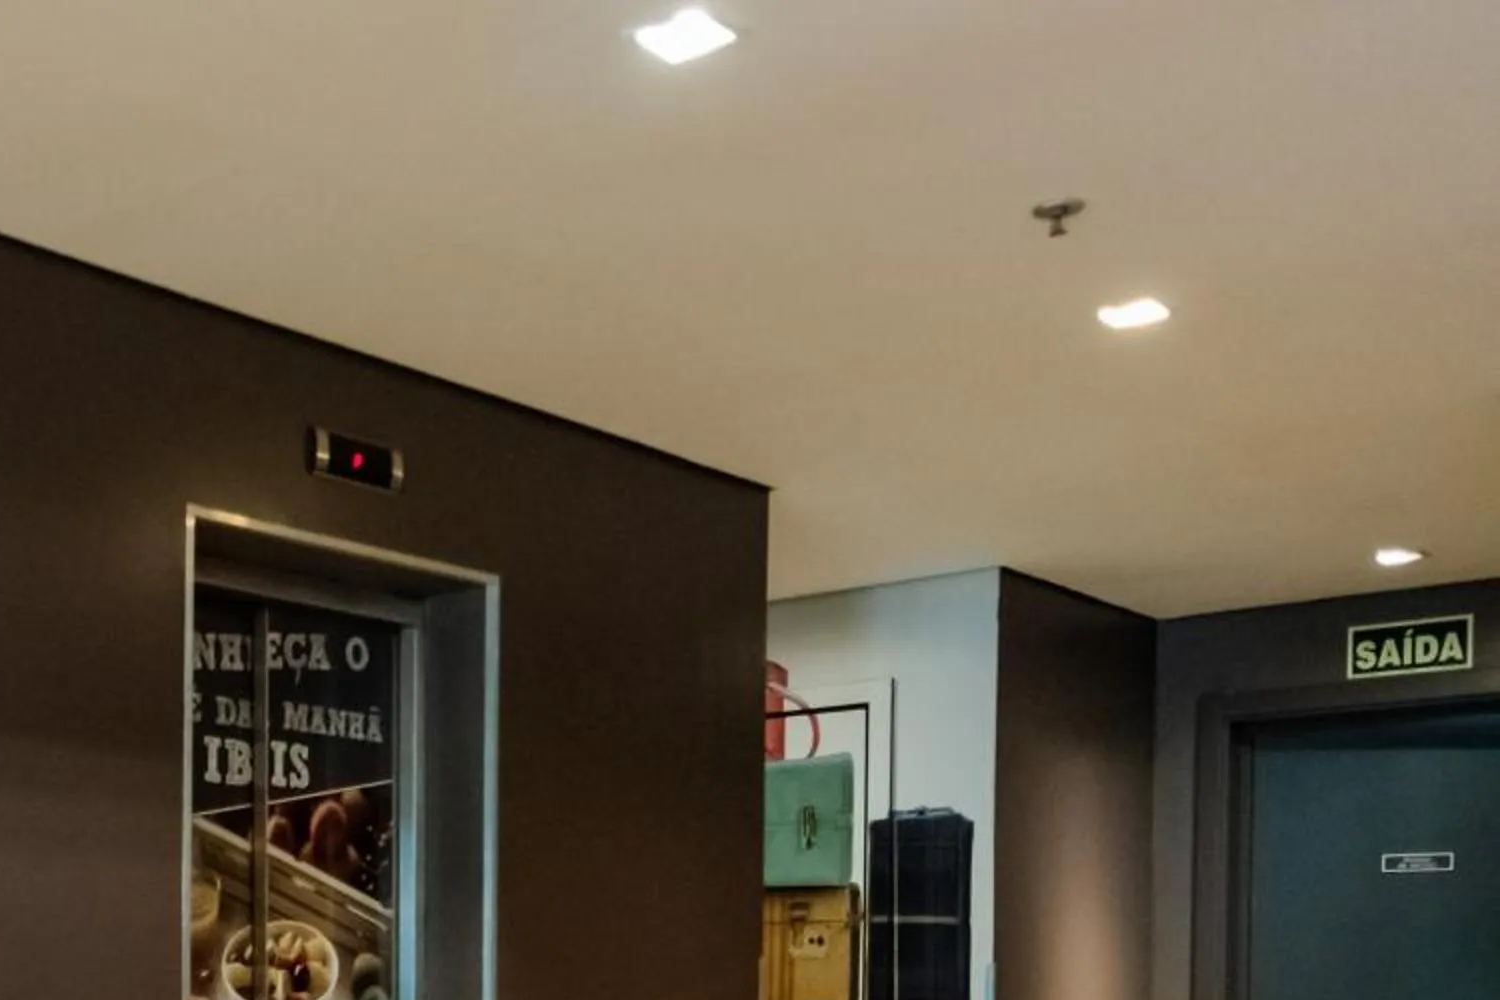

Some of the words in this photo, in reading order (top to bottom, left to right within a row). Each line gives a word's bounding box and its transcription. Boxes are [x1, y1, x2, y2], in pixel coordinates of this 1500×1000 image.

[193, 632, 331, 686] NHEÇA
[345, 635, 370, 672] O
[1355, 628, 1464, 670] SAÍDA
[203, 735, 310, 789] IBIS
